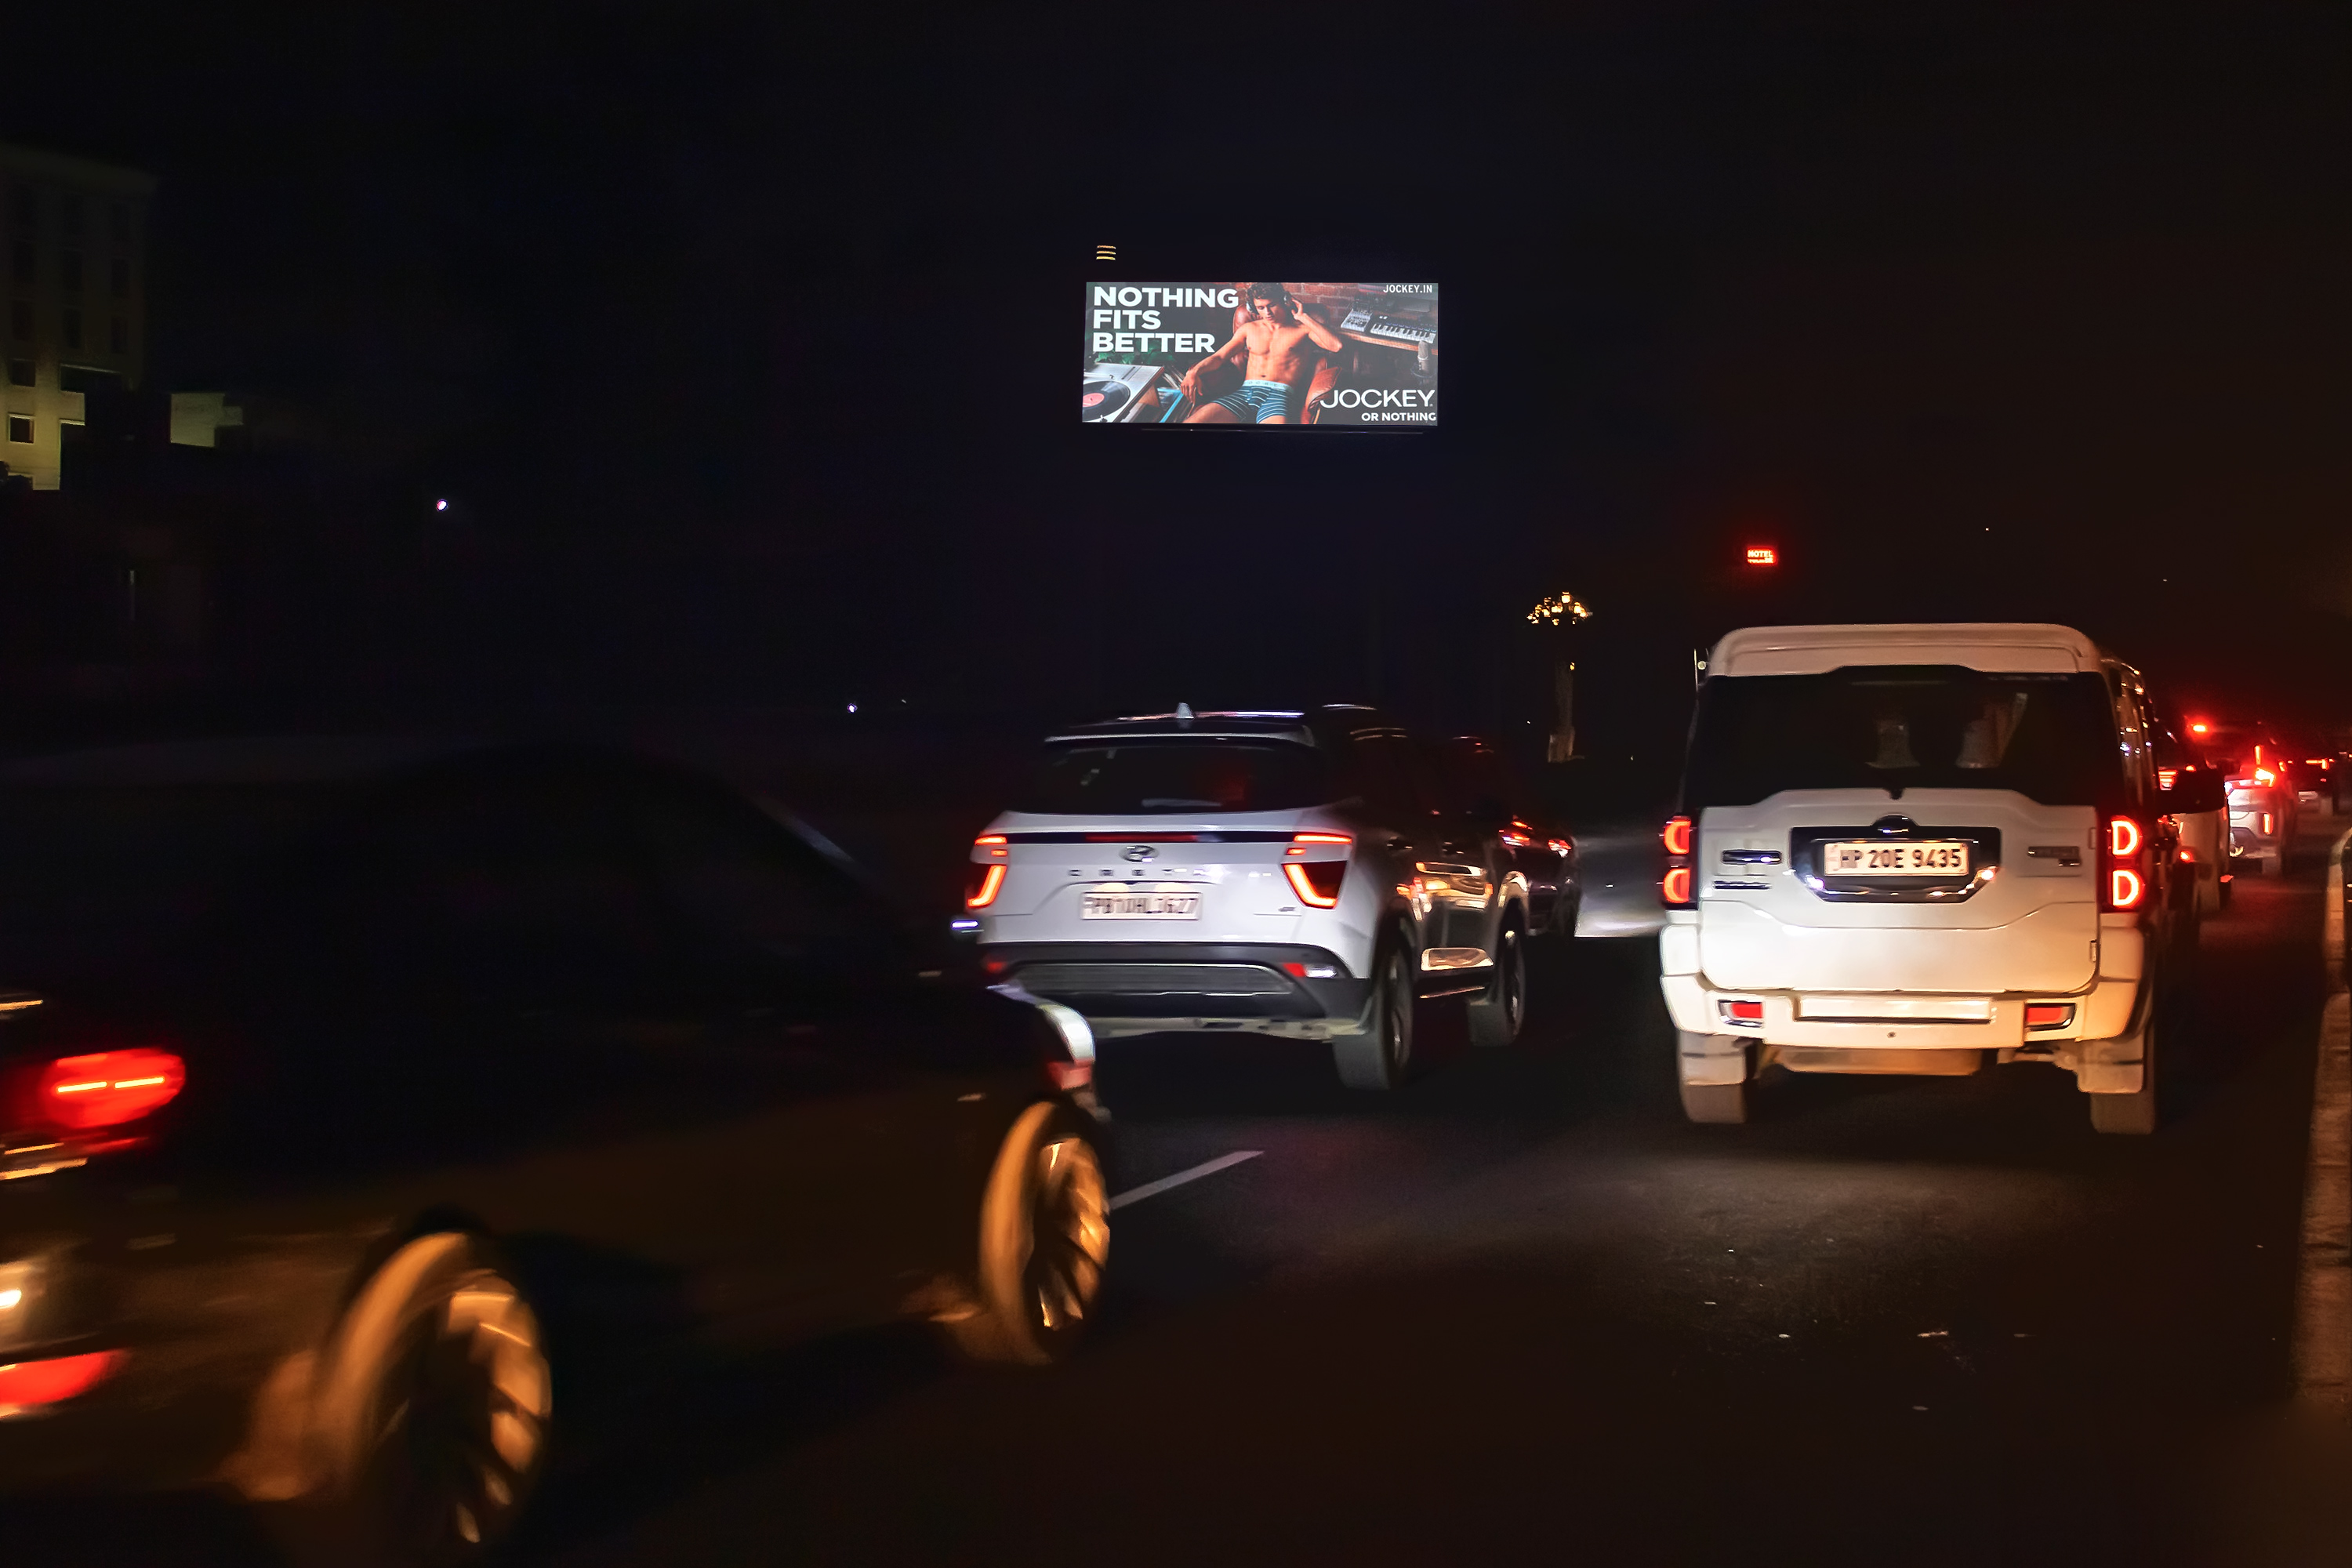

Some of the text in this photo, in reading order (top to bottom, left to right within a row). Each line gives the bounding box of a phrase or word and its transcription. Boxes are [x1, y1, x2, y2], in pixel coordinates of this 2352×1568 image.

[1094, 286, 1239, 309] NOTHING
[1383, 285, 1432, 293] JOCKEY.IN
[1093, 309, 1161, 330] FITS
[1092, 332, 1215, 353] BETTER
[1319, 389, 1435, 408] JOCKEY
[1361, 412, 1436, 422] OR NOTHING
[1912, 848, 1961, 868] 9435
